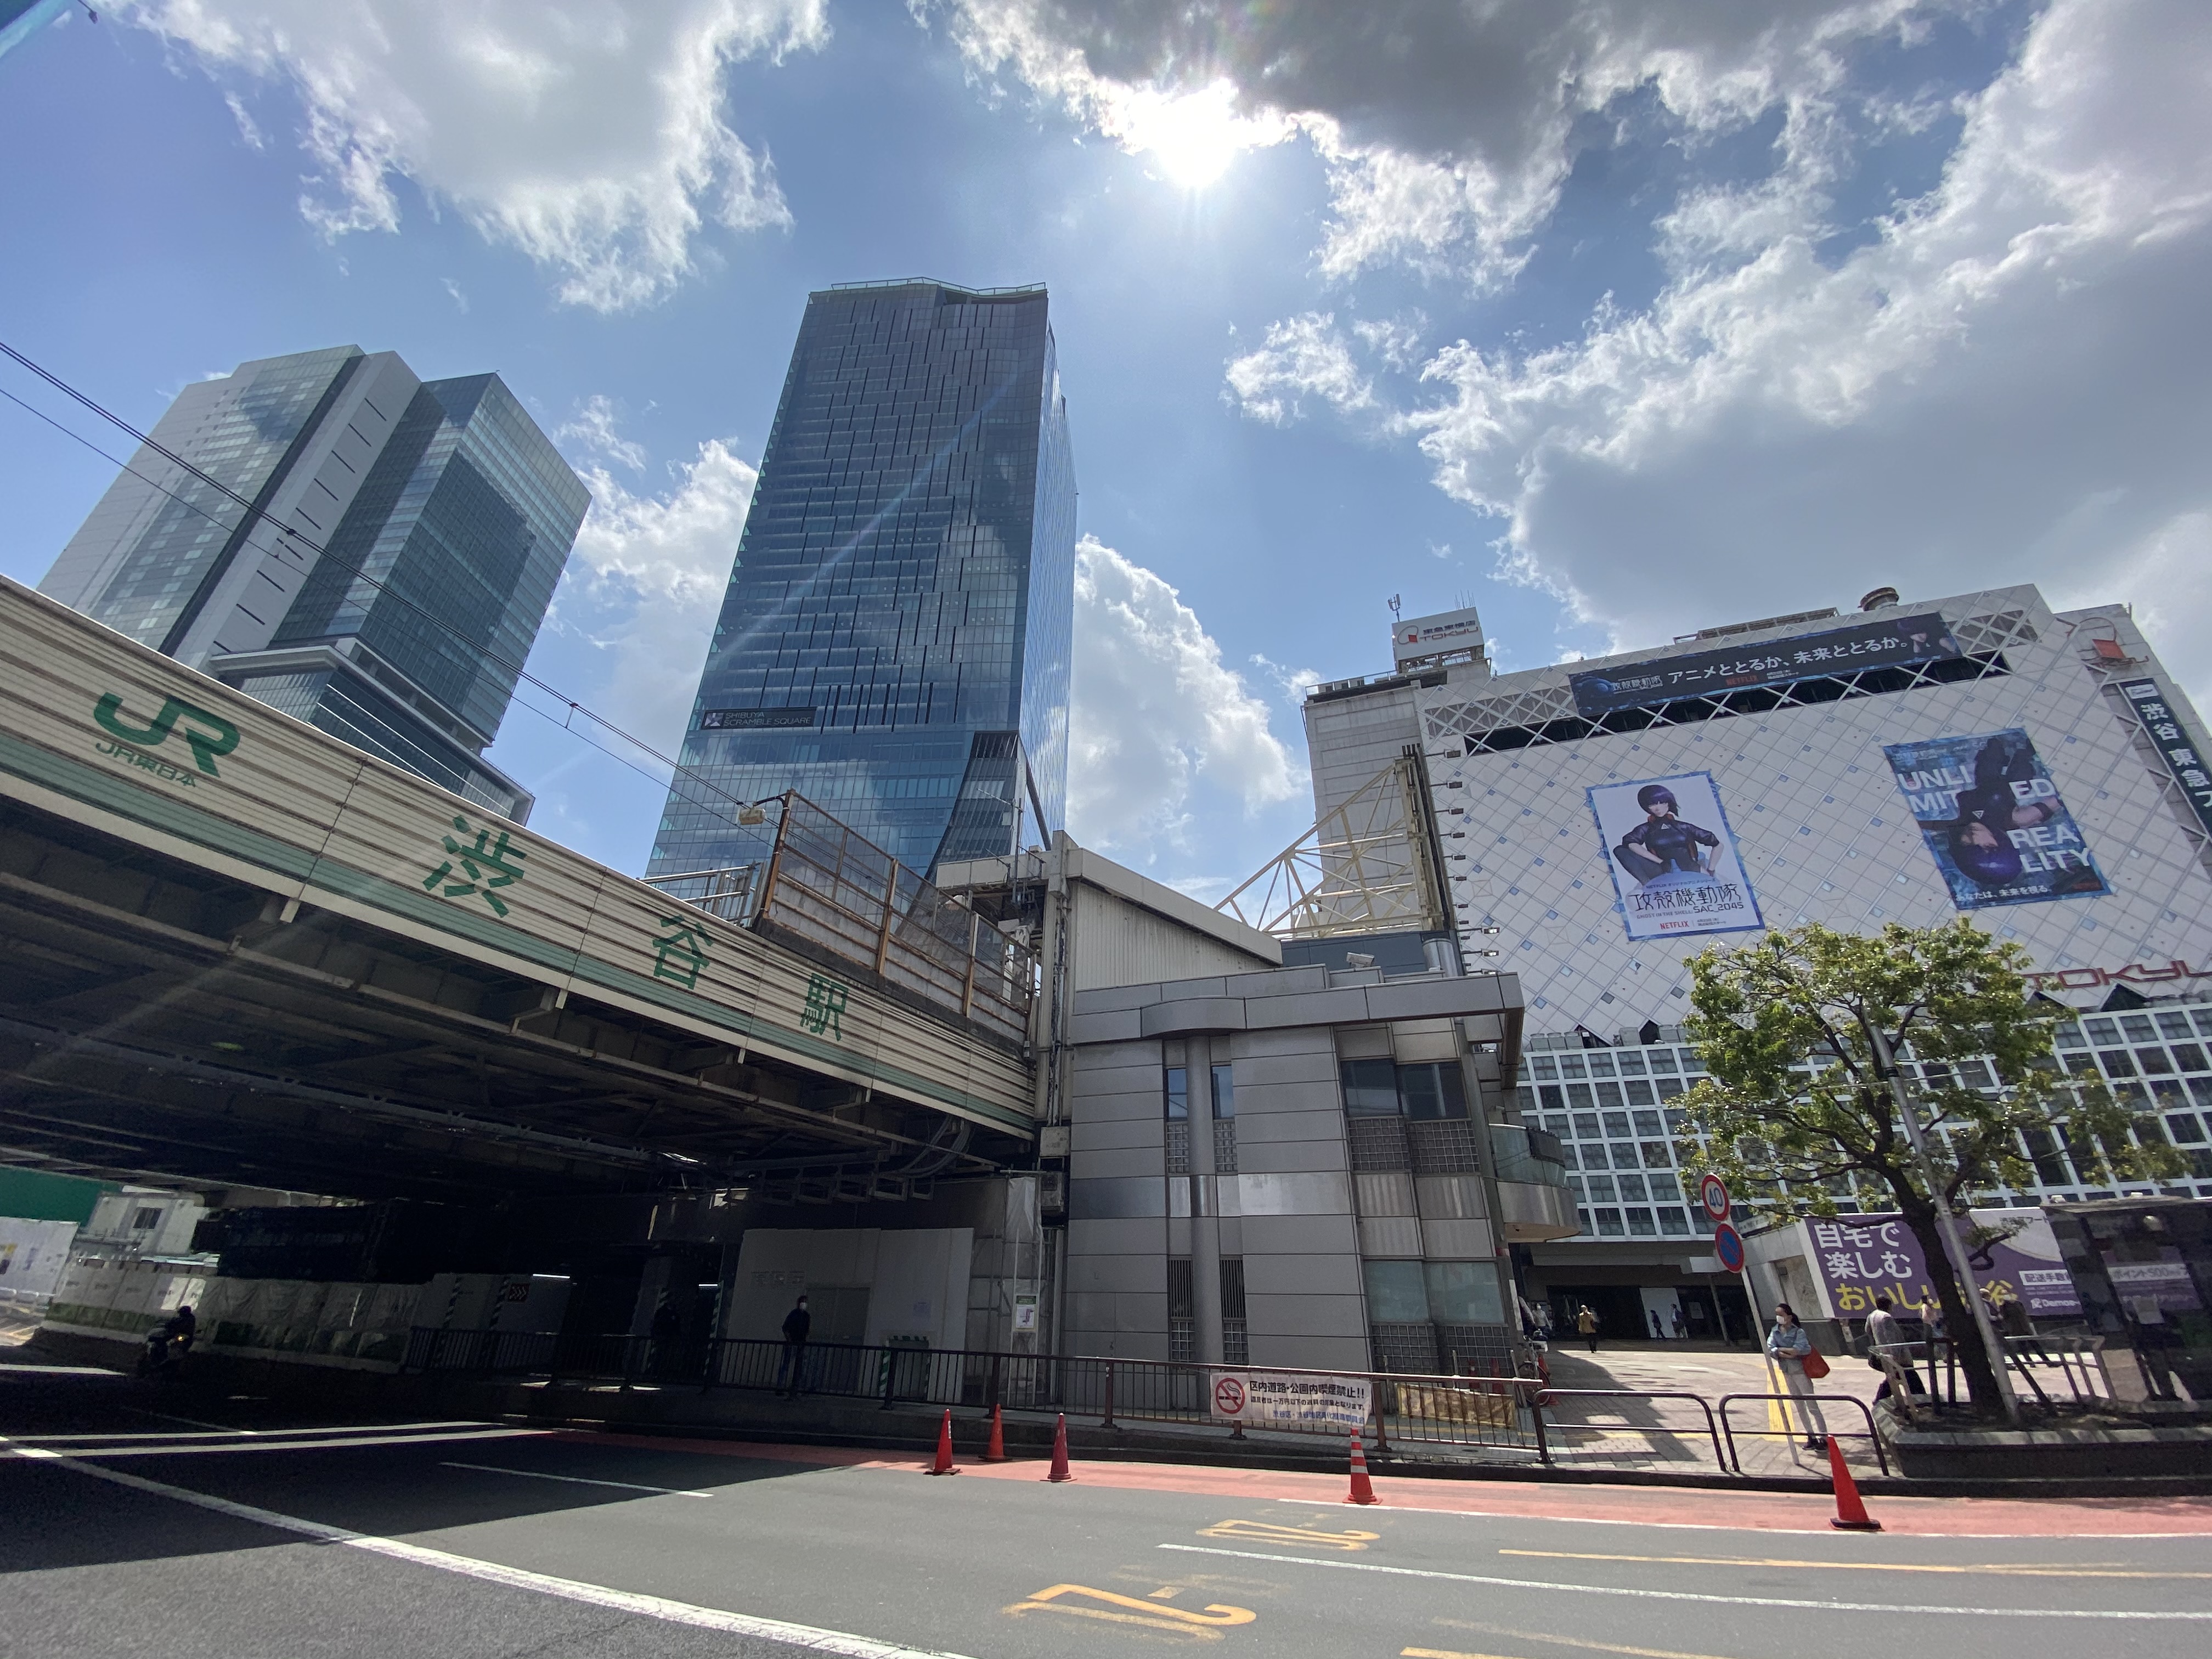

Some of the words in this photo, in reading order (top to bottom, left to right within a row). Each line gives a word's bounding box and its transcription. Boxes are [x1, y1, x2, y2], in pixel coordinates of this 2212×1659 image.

[1420, 626, 1479, 641] TOKYU
[1668, 637, 1908, 684] アニメととるか、未来ととるか。
[723, 718, 772, 727] SCRAMBLE
[774, 716, 811, 725] SQUARE
[94, 691, 240, 778] JR
[95, 742, 196, 788] JR東日本
[1898, 765, 1973, 791] UNLI
[2008, 778, 2057, 800] ED
[2006, 824, 2080, 849] REA
[2019, 848, 2092, 873] LITY
[1628, 883, 1741, 911] 攻殻機動隊
[1693, 901, 1744, 913] SAC_2045
[1660, 921, 1690, 930] NETFLIX
[1709, 1187, 1723, 1208] 40
[1814, 1222, 1900, 1249] 自宅で
[1824, 1250, 1912, 1279] 楽しむ
